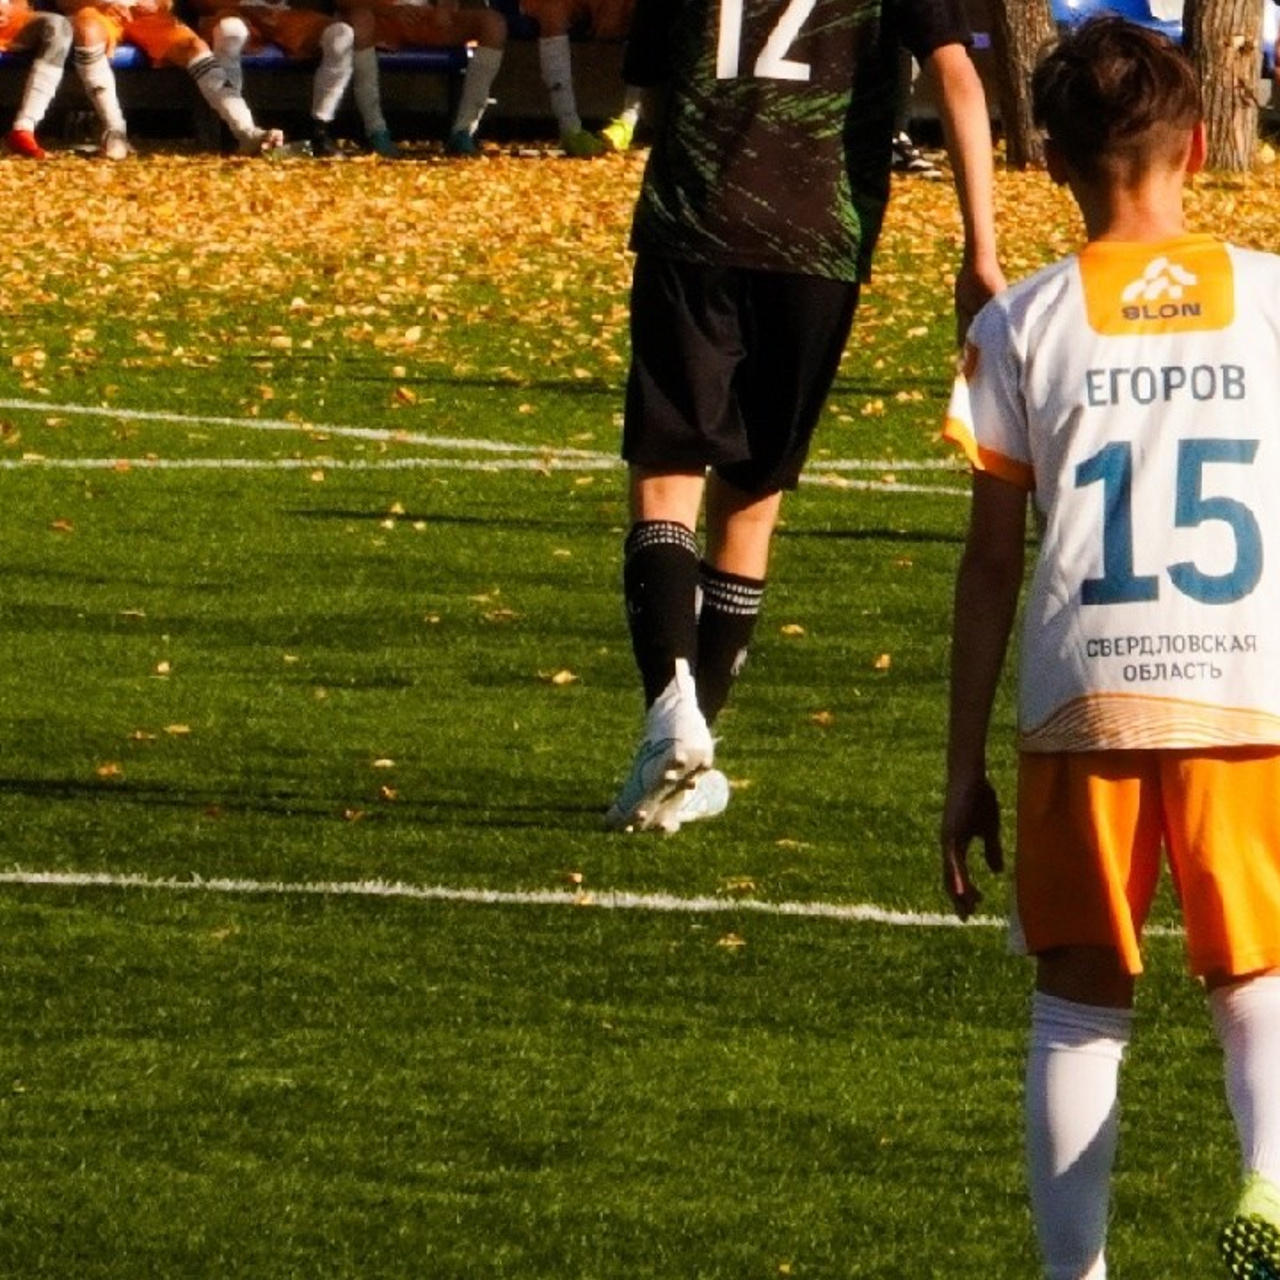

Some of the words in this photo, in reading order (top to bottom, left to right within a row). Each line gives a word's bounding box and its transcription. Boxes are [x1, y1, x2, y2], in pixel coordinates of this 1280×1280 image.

[1121, 303, 1201, 320] SLON
[1086, 364, 1246, 407] ЕГОРОВ
[1074, 438, 1264, 605] 15
[1086, 634, 1257, 658] СВЕРДЛОВСКАЯ
[1123, 661, 1222, 681] ОБЛАСТЬ
